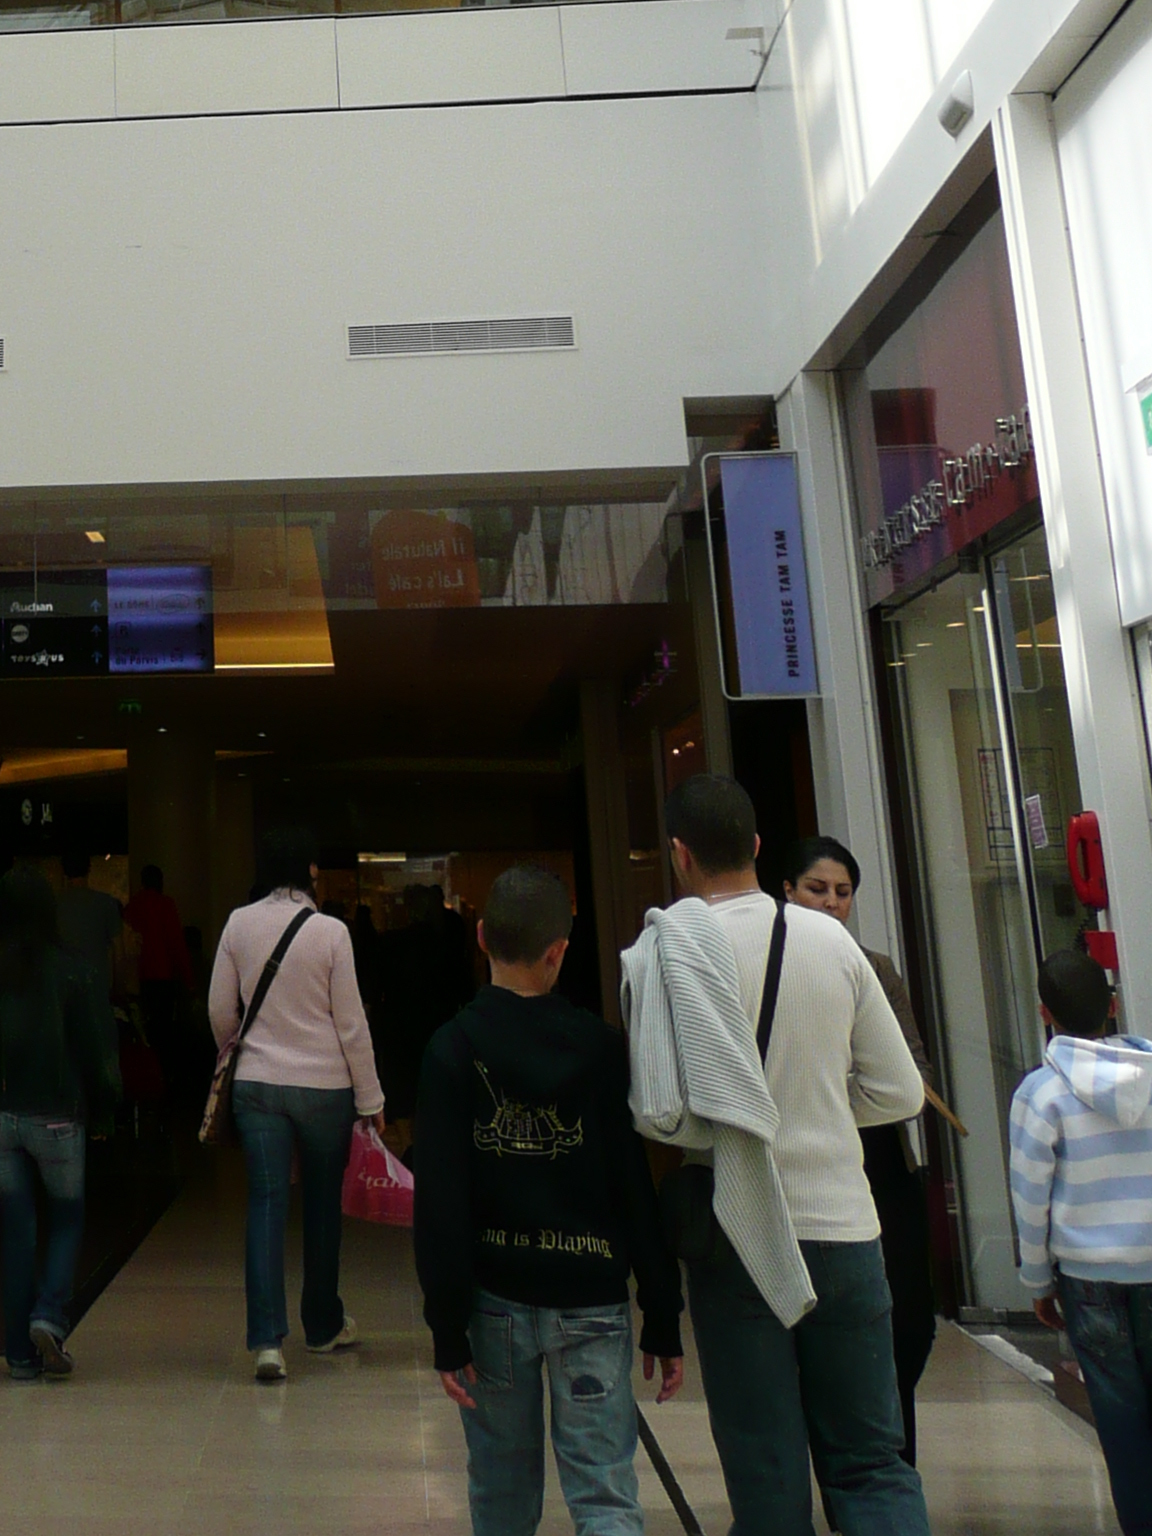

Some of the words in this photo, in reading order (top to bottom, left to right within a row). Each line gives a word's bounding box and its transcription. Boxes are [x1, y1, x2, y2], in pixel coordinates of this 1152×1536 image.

[774, 529, 788, 558] TAM
[777, 564, 791, 593] TAM
[9, 600, 54, 613] Auchan
[781, 598, 800, 678] PRINCESSE
[513, 1232, 531, 1246] is
[535, 1228, 614, 1260] Playing
